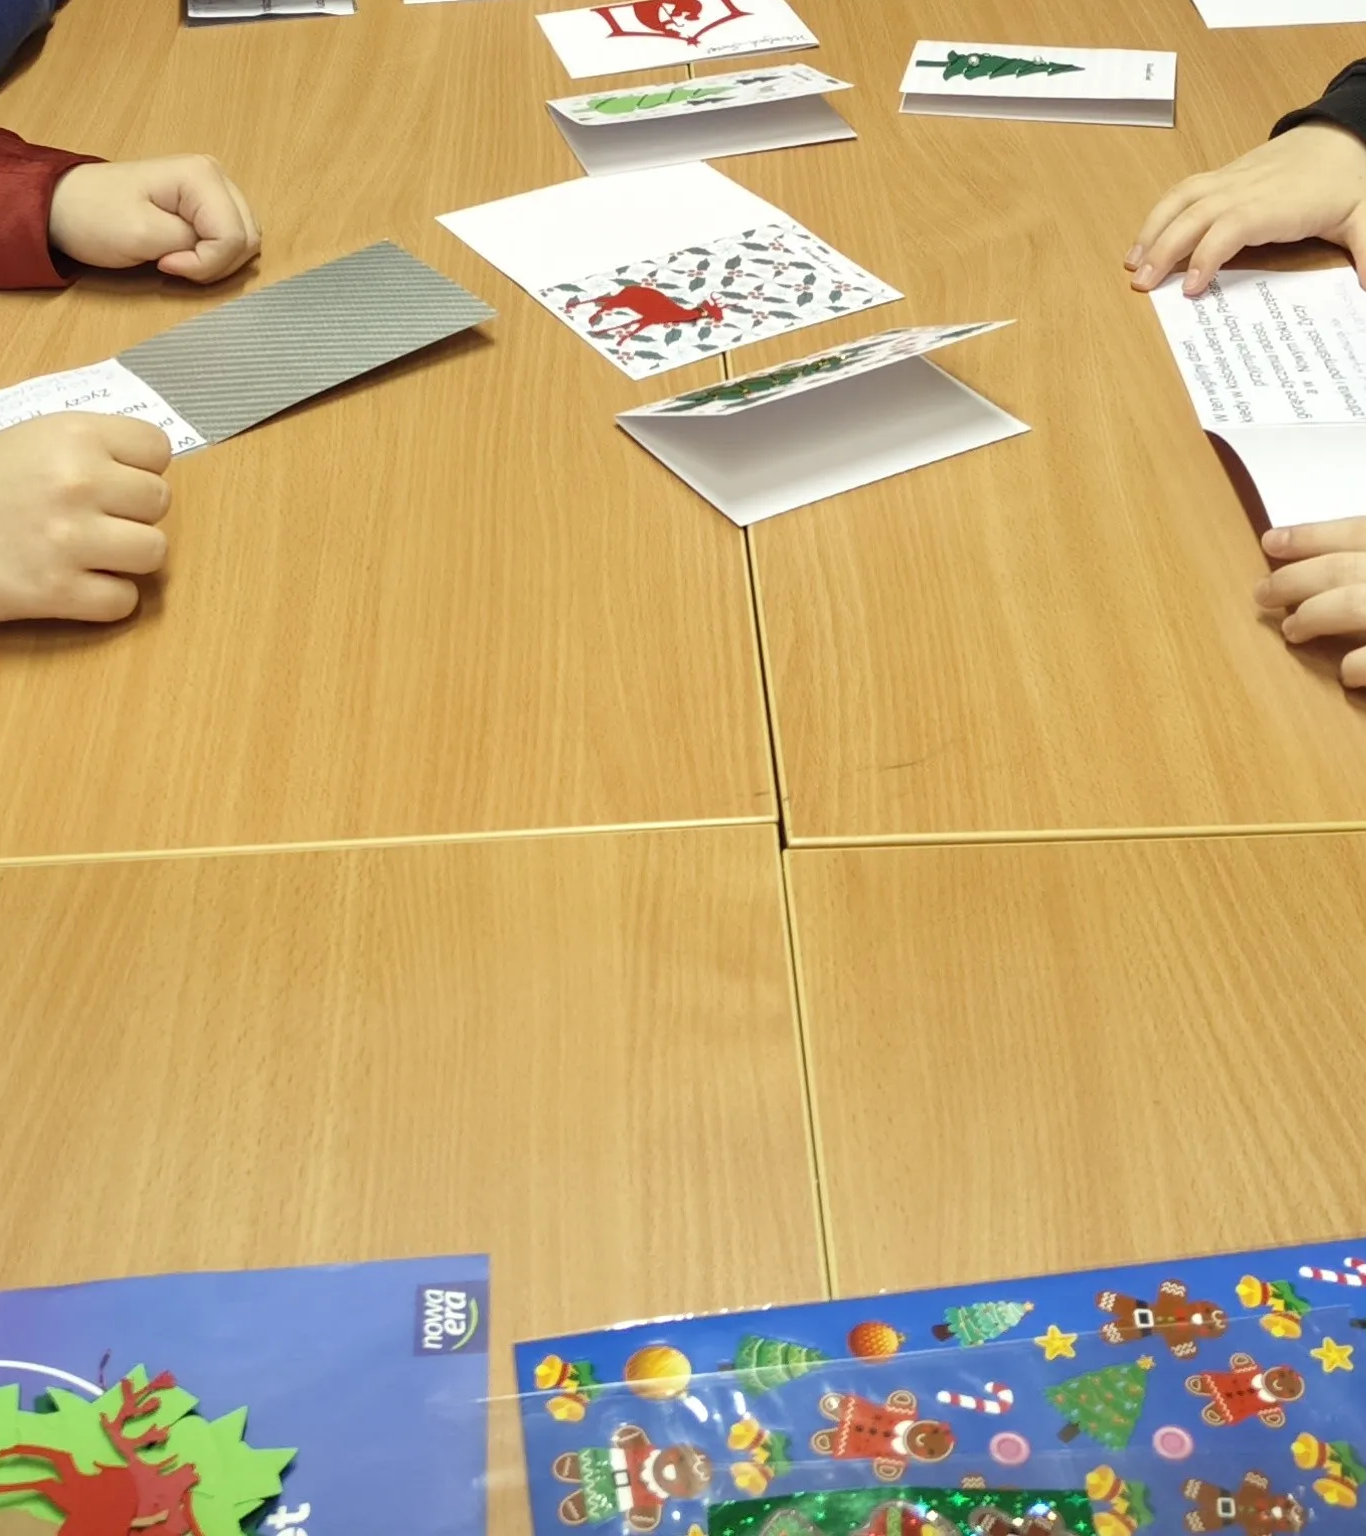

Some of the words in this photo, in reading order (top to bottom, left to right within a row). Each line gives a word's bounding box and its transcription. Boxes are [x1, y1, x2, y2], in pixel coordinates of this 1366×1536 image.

[64, 387, 111, 406] Życzy
[423, 1286, 445, 1352] nowa
[442, 1290, 469, 1348] era
